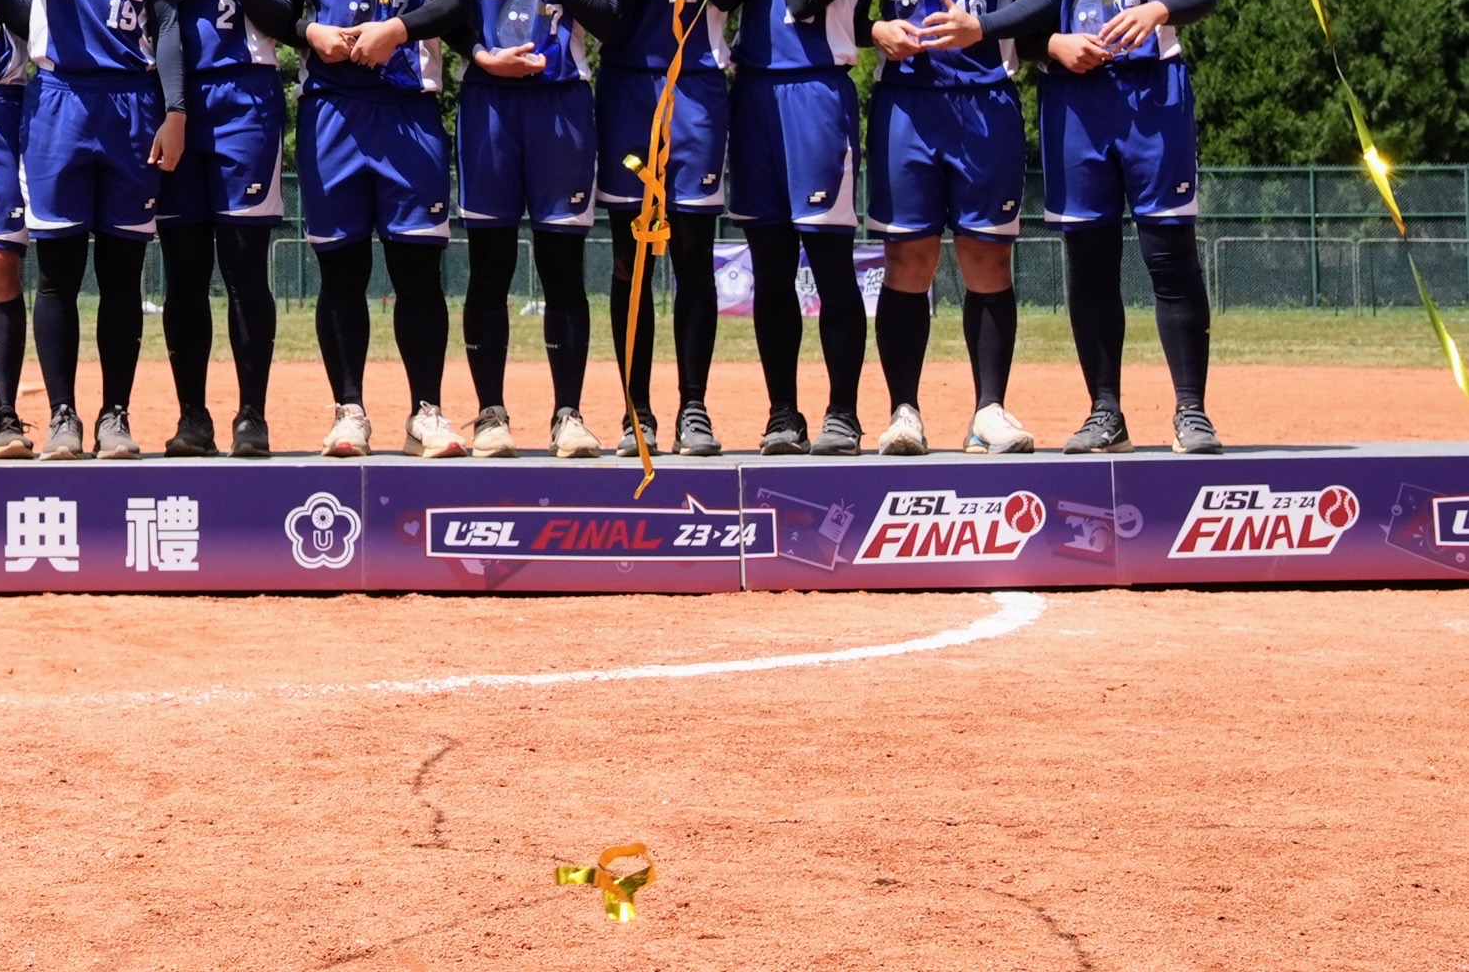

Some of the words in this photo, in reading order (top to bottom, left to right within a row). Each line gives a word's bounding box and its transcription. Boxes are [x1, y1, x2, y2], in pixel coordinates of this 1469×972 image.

[888, 496, 950, 516] USL
[1202, 491, 1264, 510] USL
[443, 521, 519, 547] USL
[530, 519, 663, 550] FINAL
[861, 520, 1021, 559] FINAL
[1176, 515, 1336, 553] FINAL
